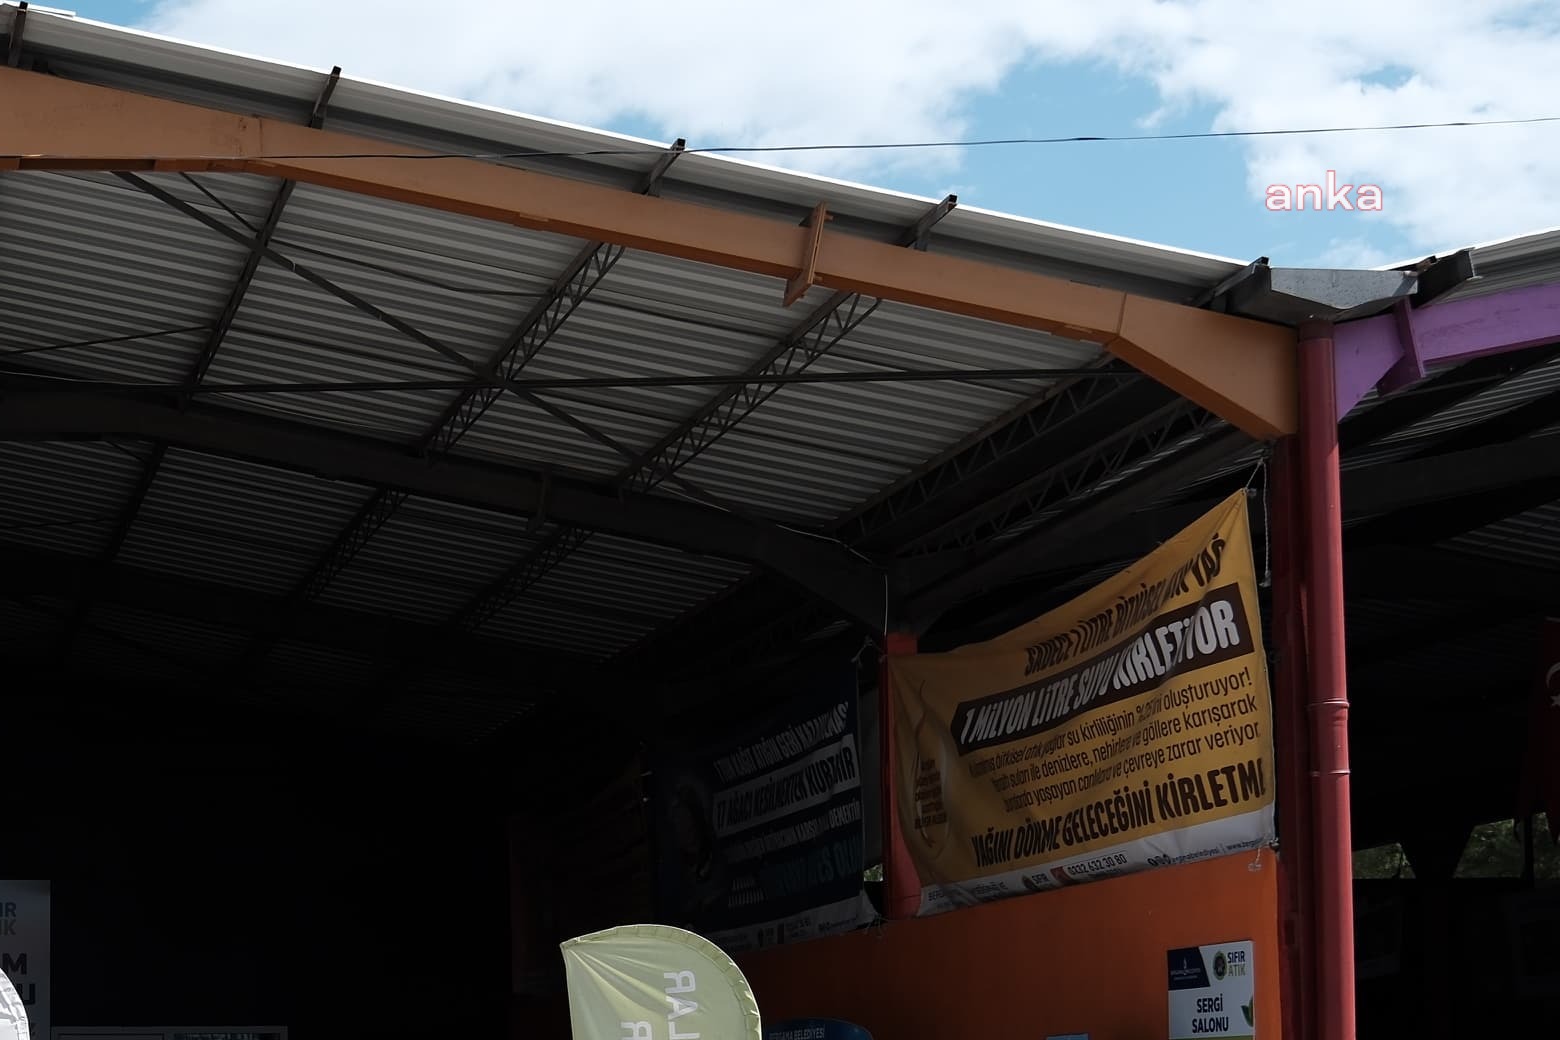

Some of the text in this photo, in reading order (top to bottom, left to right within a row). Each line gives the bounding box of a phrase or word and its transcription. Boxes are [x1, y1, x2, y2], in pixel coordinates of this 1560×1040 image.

[960, 599, 1241, 745] 1 MİLYON LİTRE SUYU KİRLETİYOR
[1066, 730, 1081, 748] su
[1080, 708, 1137, 744] kirliliğinin
[1161, 665, 1253, 716] oluşturuyor!
[1034, 776, 1079, 808] yaşayan
[1123, 748, 1167, 780] çevreye
[1167, 738, 1203, 764] zarar
[1205, 720, 1262, 754] veriyor
[1042, 749, 1095, 780] denizlere,
[1142, 718, 1183, 749] göllere
[1183, 694, 1259, 731] karışarak
[971, 826, 1014, 869] YAĞINI
[1014, 814, 1063, 861] DÖKME
[1061, 779, 1156, 848] GELECEĞİNİ
[1227, 950, 1246, 964] SIFIR
[1192, 1016, 1229, 1034] SALONU
[1196, 993, 1223, 1013] SERGİ
